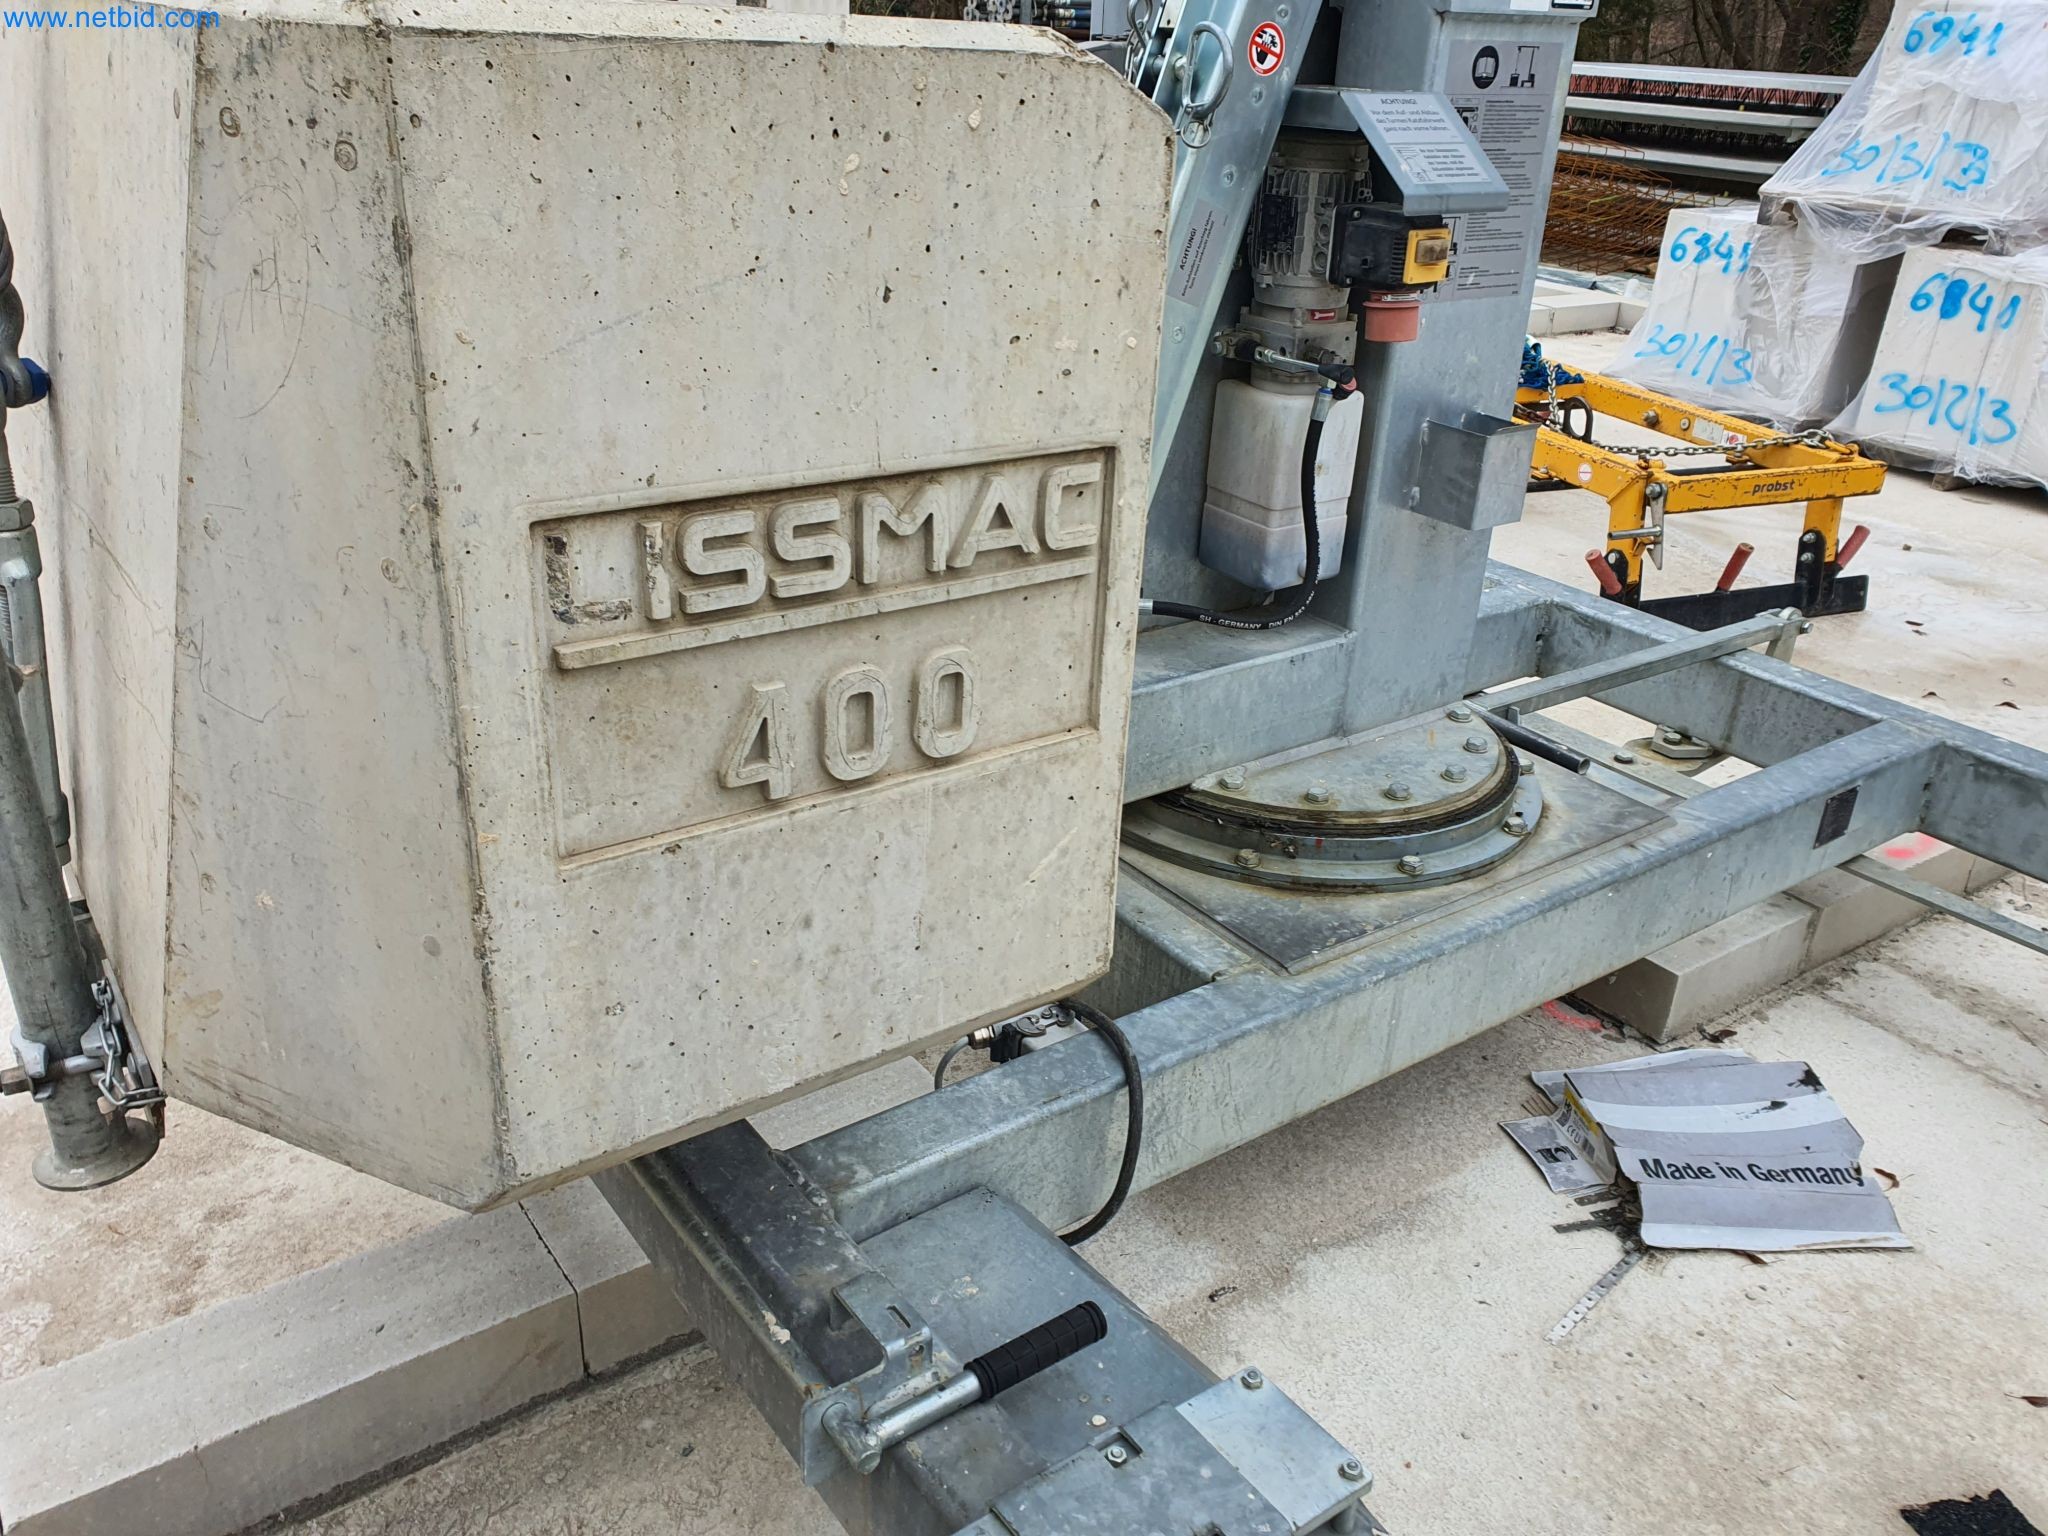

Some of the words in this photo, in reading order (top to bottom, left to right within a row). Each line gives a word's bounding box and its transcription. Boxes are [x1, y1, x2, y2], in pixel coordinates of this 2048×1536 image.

[1179, 228, 1198, 270] ACHTUNG!
[1752, 478, 1796, 496] probst
[1218, 618, 1262, 630] GERMANY
[719, 644, 984, 801] 400
[1638, 1157, 1717, 1180] Made
[1715, 1161, 1748, 1182] in
[1747, 1162, 1865, 1187] Germany
